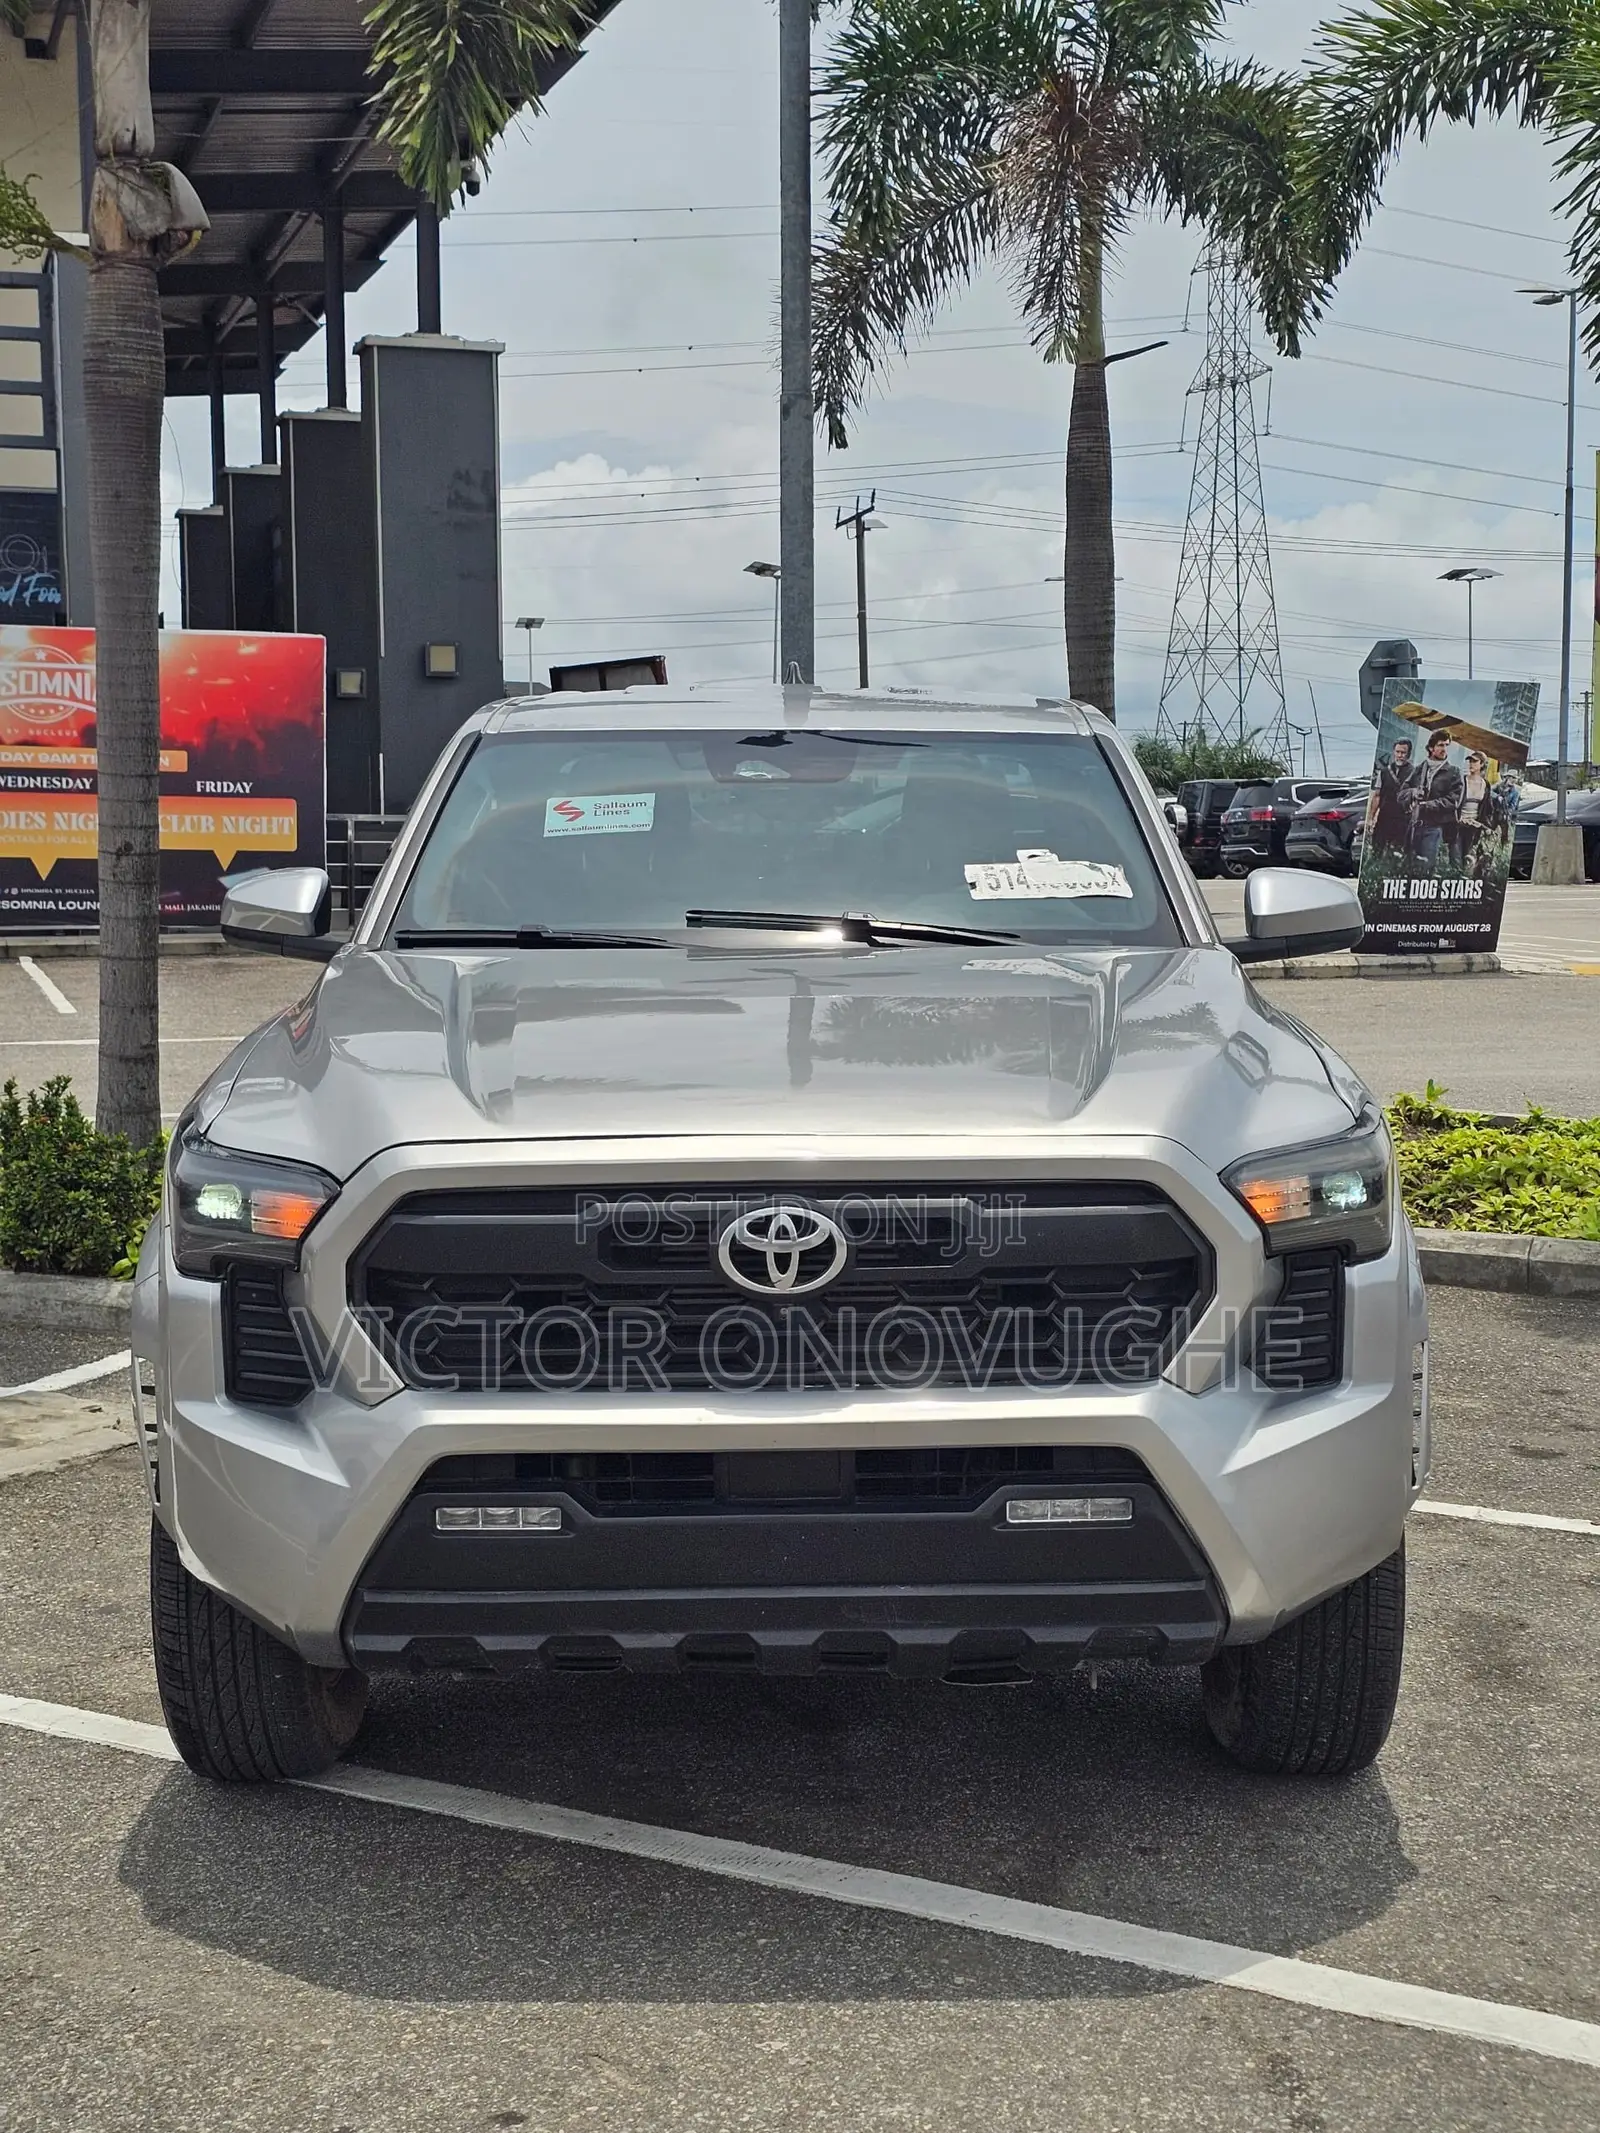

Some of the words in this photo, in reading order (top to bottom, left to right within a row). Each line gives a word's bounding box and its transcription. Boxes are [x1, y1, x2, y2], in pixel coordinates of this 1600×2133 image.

[0, 669, 97, 703] SOMNI
[196, 780, 253, 794] FRIDAY
[593, 800, 647, 811] Sallaum
[593, 809, 631, 817] Lines
[159, 814, 216, 833] CLUB
[222, 815, 294, 835] NIGHT
[1382, 879, 1408, 899] THE
[1409, 879, 1439, 900] DOG
[1440, 879, 1484, 899] STARS
[0, 900, 57, 910] SOMNIA
[1364, 924, 1375, 933] IN
[1376, 923, 1417, 933] CINEMAS
[1418, 924, 1444, 933] FROM
[1445, 923, 1479, 933] AUGUST
[1480, 923, 1491, 933] 28
[1397, 940, 1429, 948] Distributed
[1430, 941, 1437, 949] by
